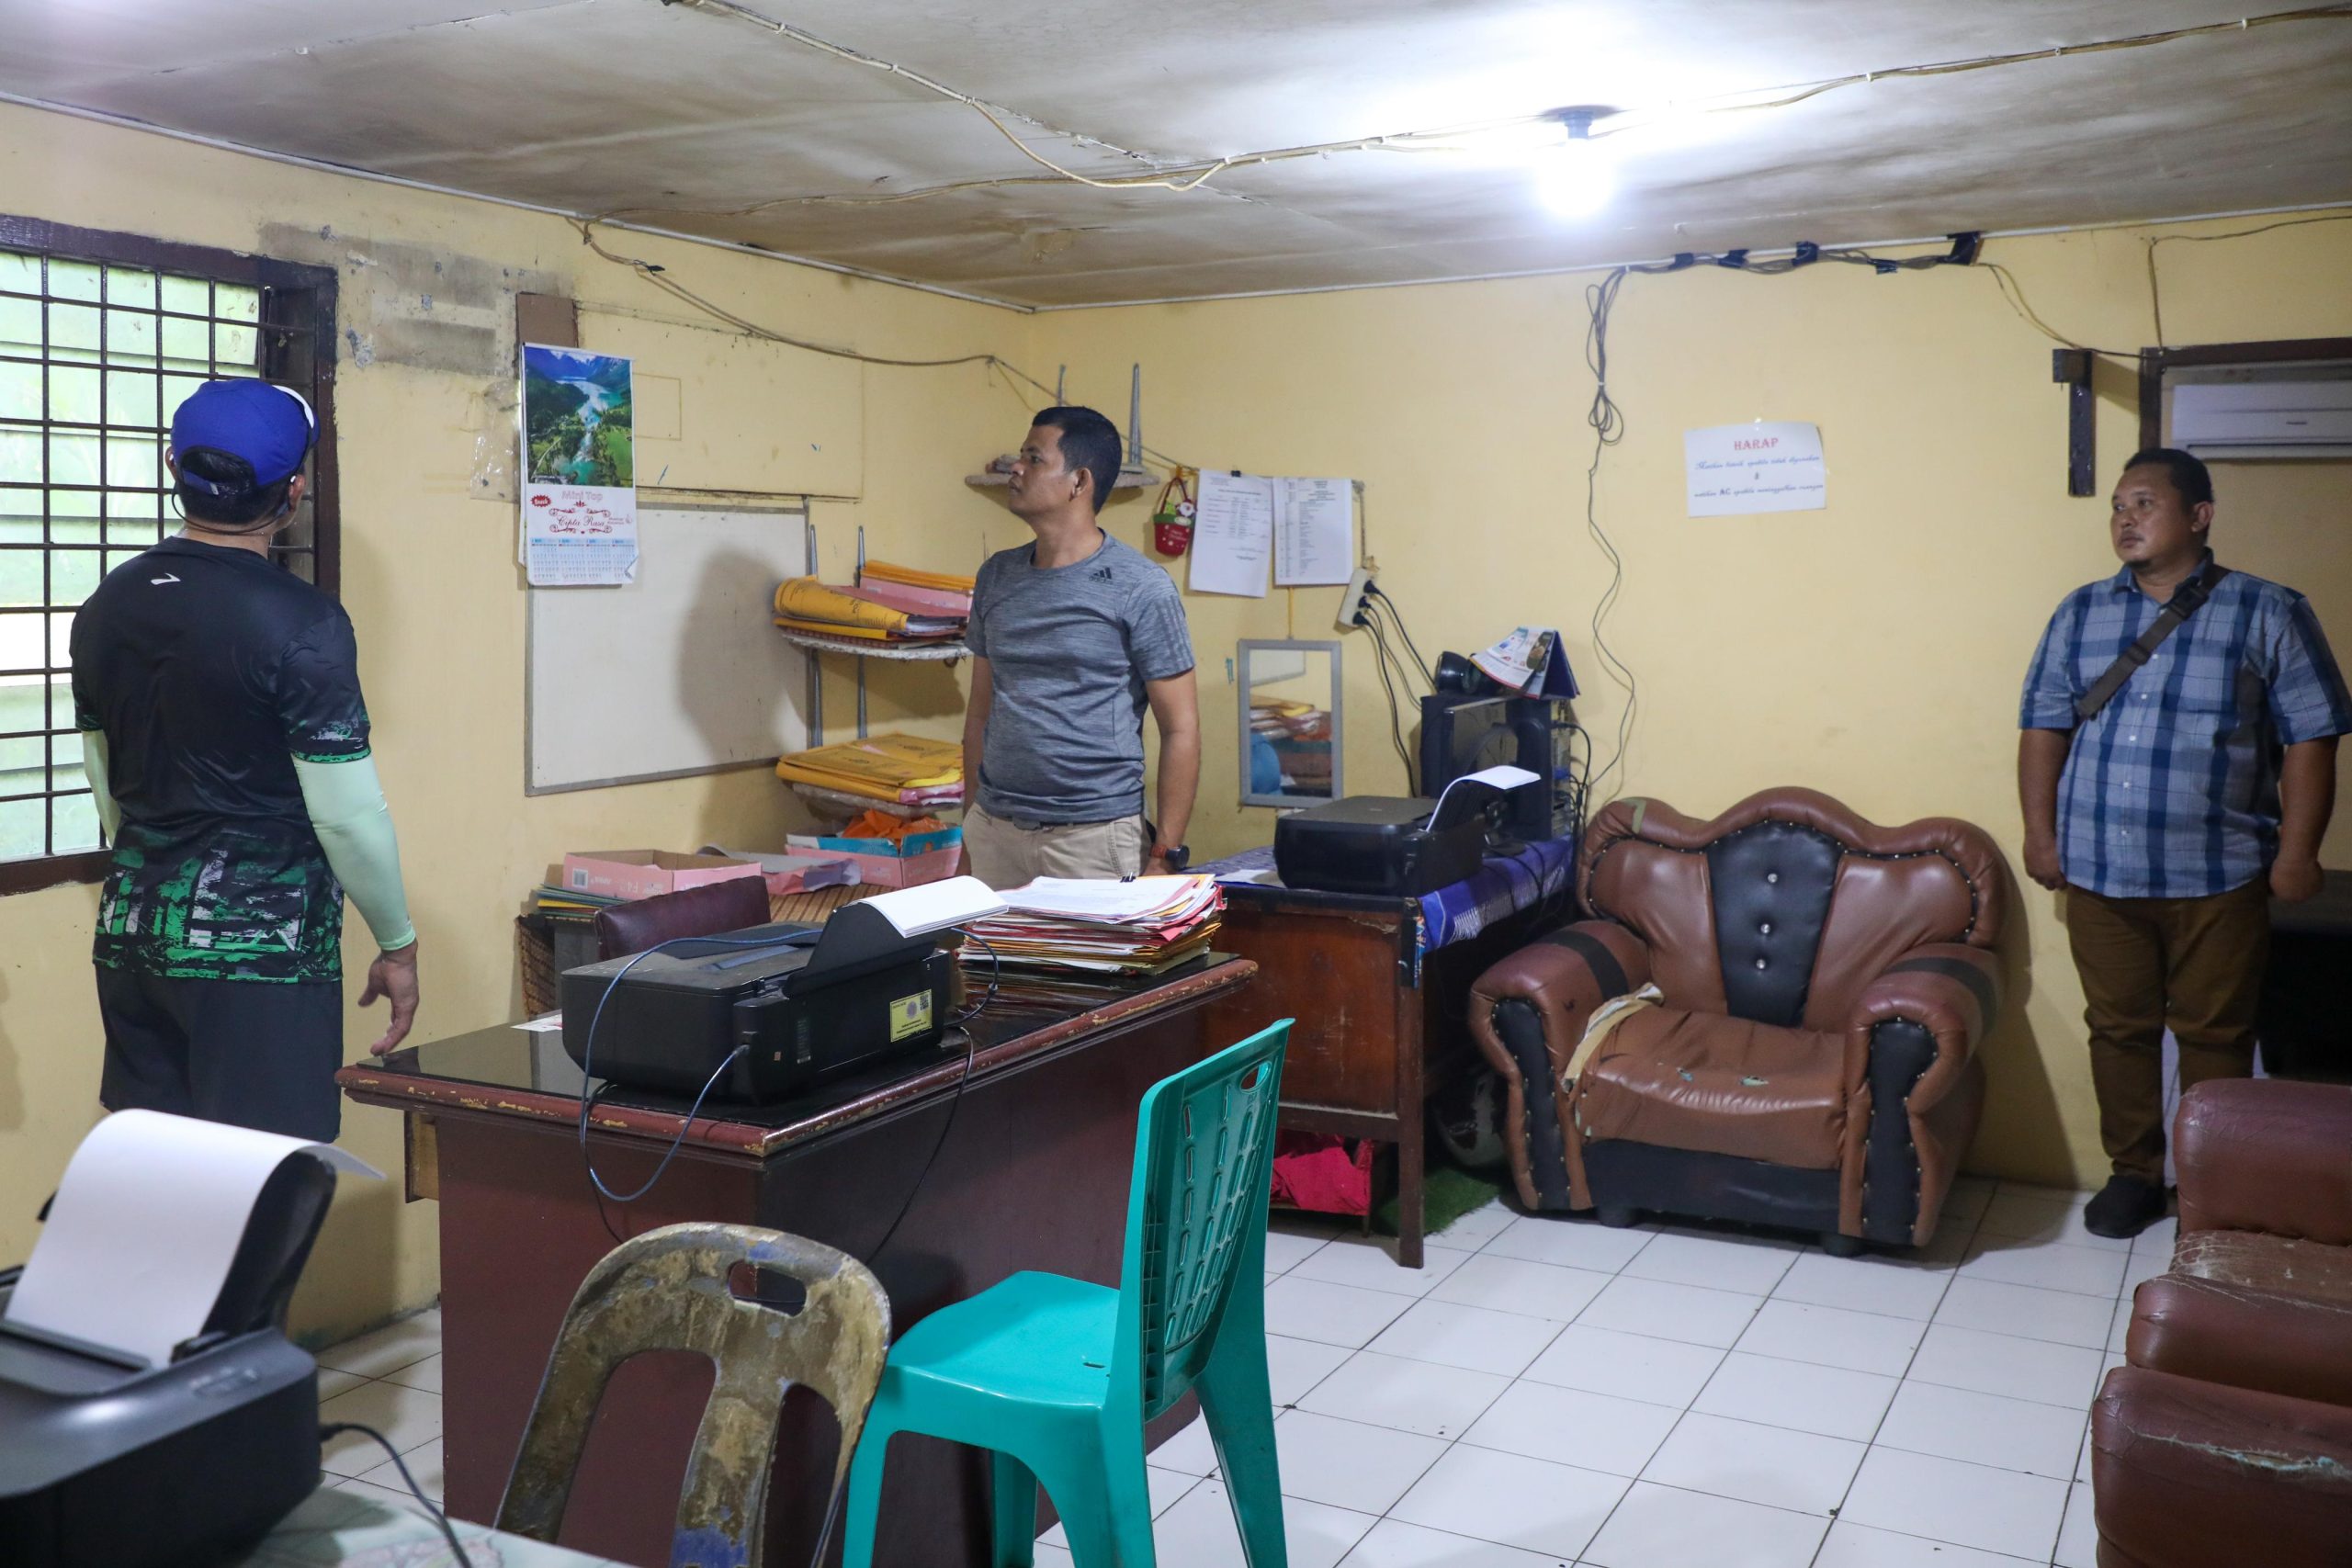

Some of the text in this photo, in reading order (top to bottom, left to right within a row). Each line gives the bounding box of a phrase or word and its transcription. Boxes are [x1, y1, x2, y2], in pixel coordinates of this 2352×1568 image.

[1734, 437, 1779, 451] HARAP
[1719, 488, 1731, 496] AC
[582, 514, 605, 527] Rasa
